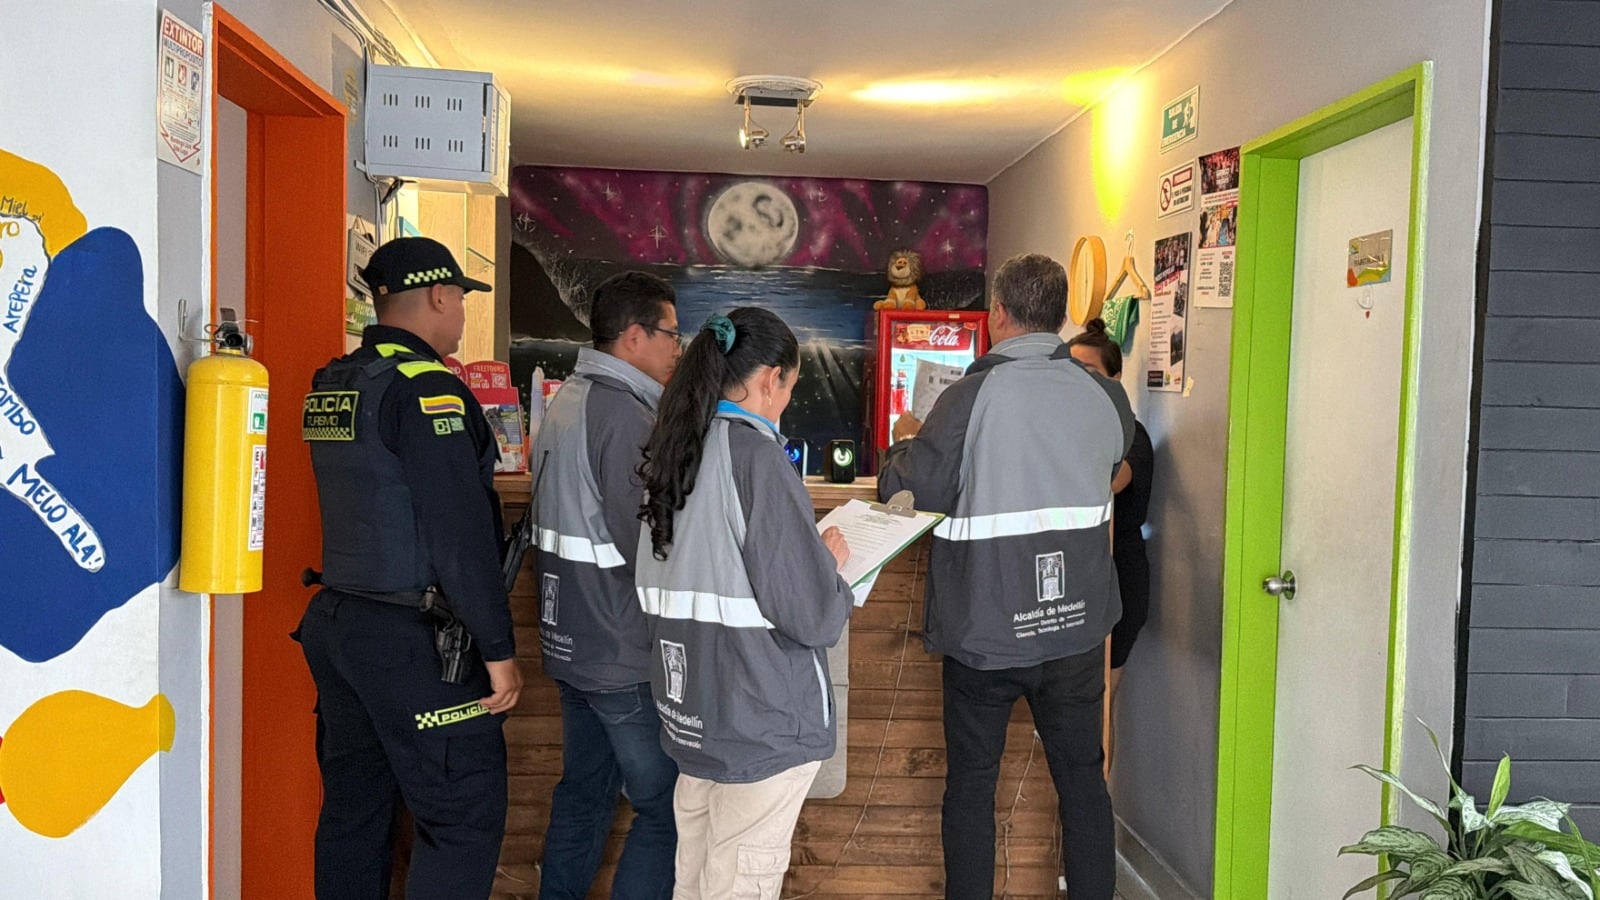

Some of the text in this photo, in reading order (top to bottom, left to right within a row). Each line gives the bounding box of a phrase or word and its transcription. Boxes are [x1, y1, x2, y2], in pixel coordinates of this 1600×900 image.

[164, 18, 203, 57] EXTINTOR
[0, 195, 28, 216] Miel
[929, 325, 960, 346] Cola
[1014, 607, 1044, 623] Alcaldía
[1046, 606, 1056, 616] de
